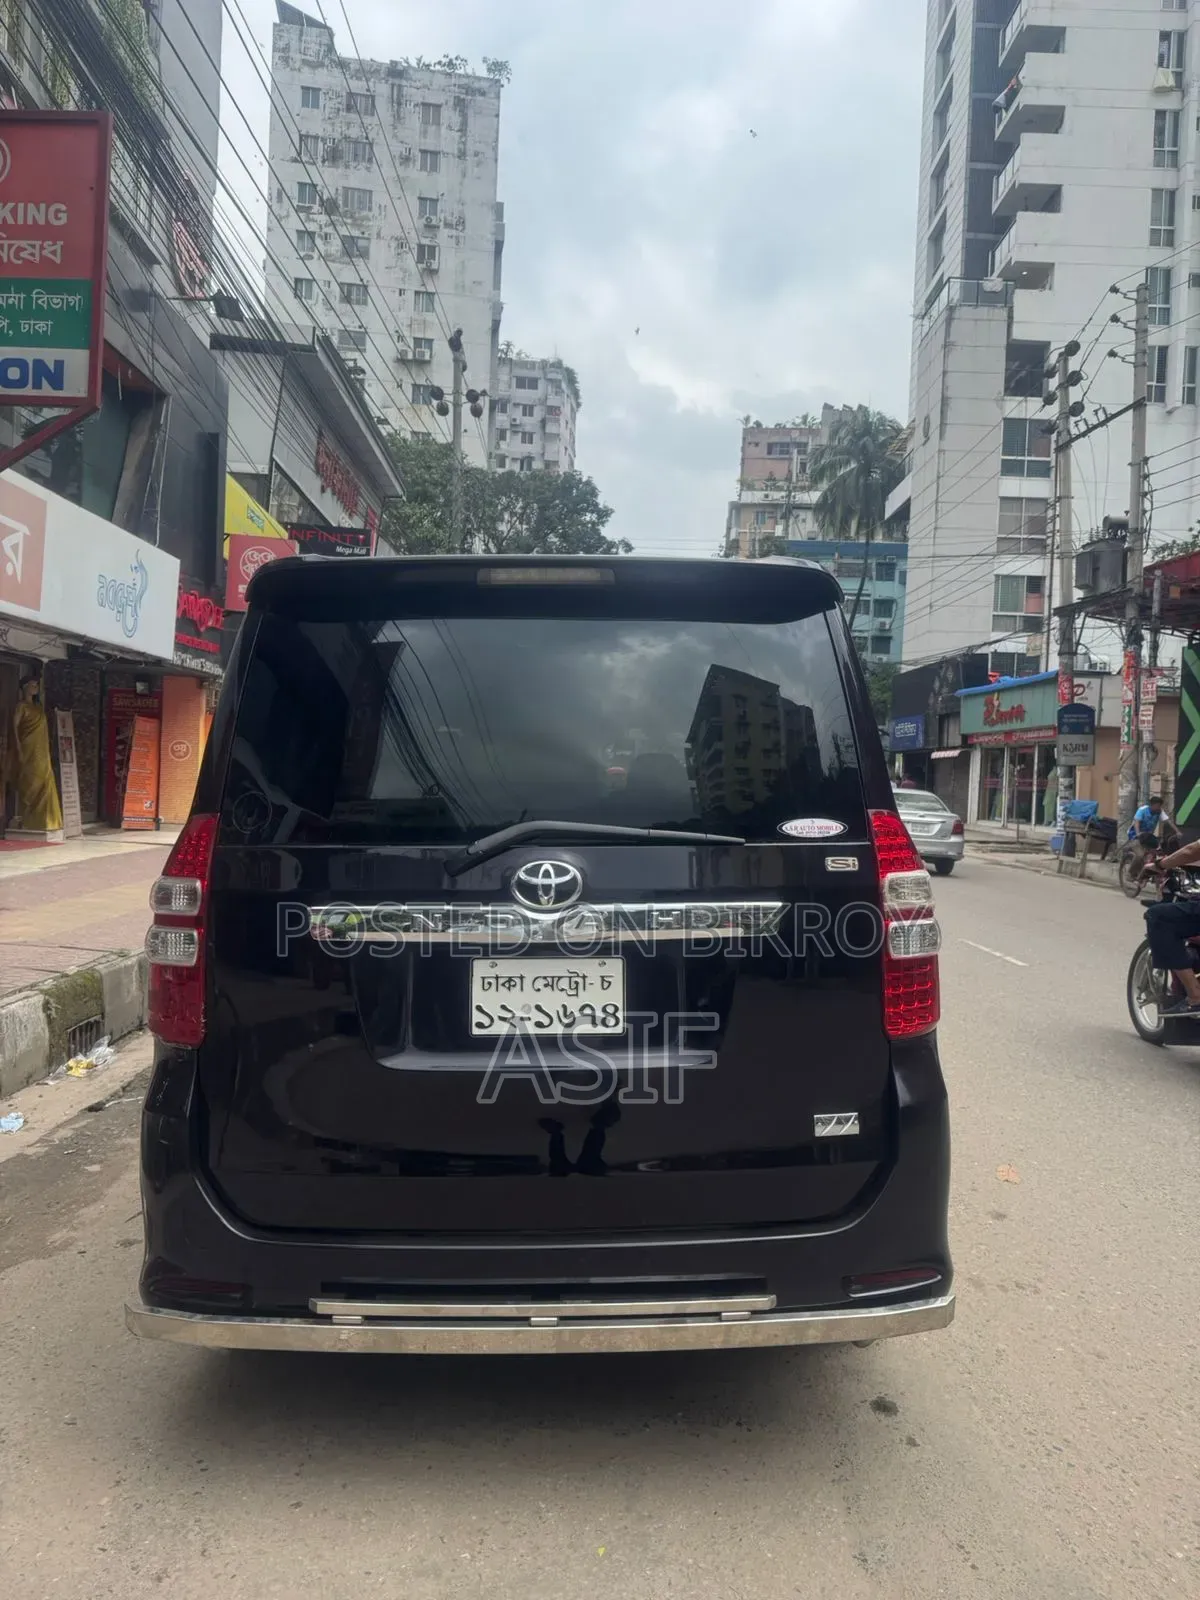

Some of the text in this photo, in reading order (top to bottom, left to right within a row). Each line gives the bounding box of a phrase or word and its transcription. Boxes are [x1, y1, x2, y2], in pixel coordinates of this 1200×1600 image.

[30, 288, 82, 312] বিভাগ
[19, 317, 54, 337] ঢাকা
[830, 858, 856, 869] Si
[480, 973, 525, 992] ঢাকা
[475, 1003, 621, 1029] ১২-১৬৭৪
